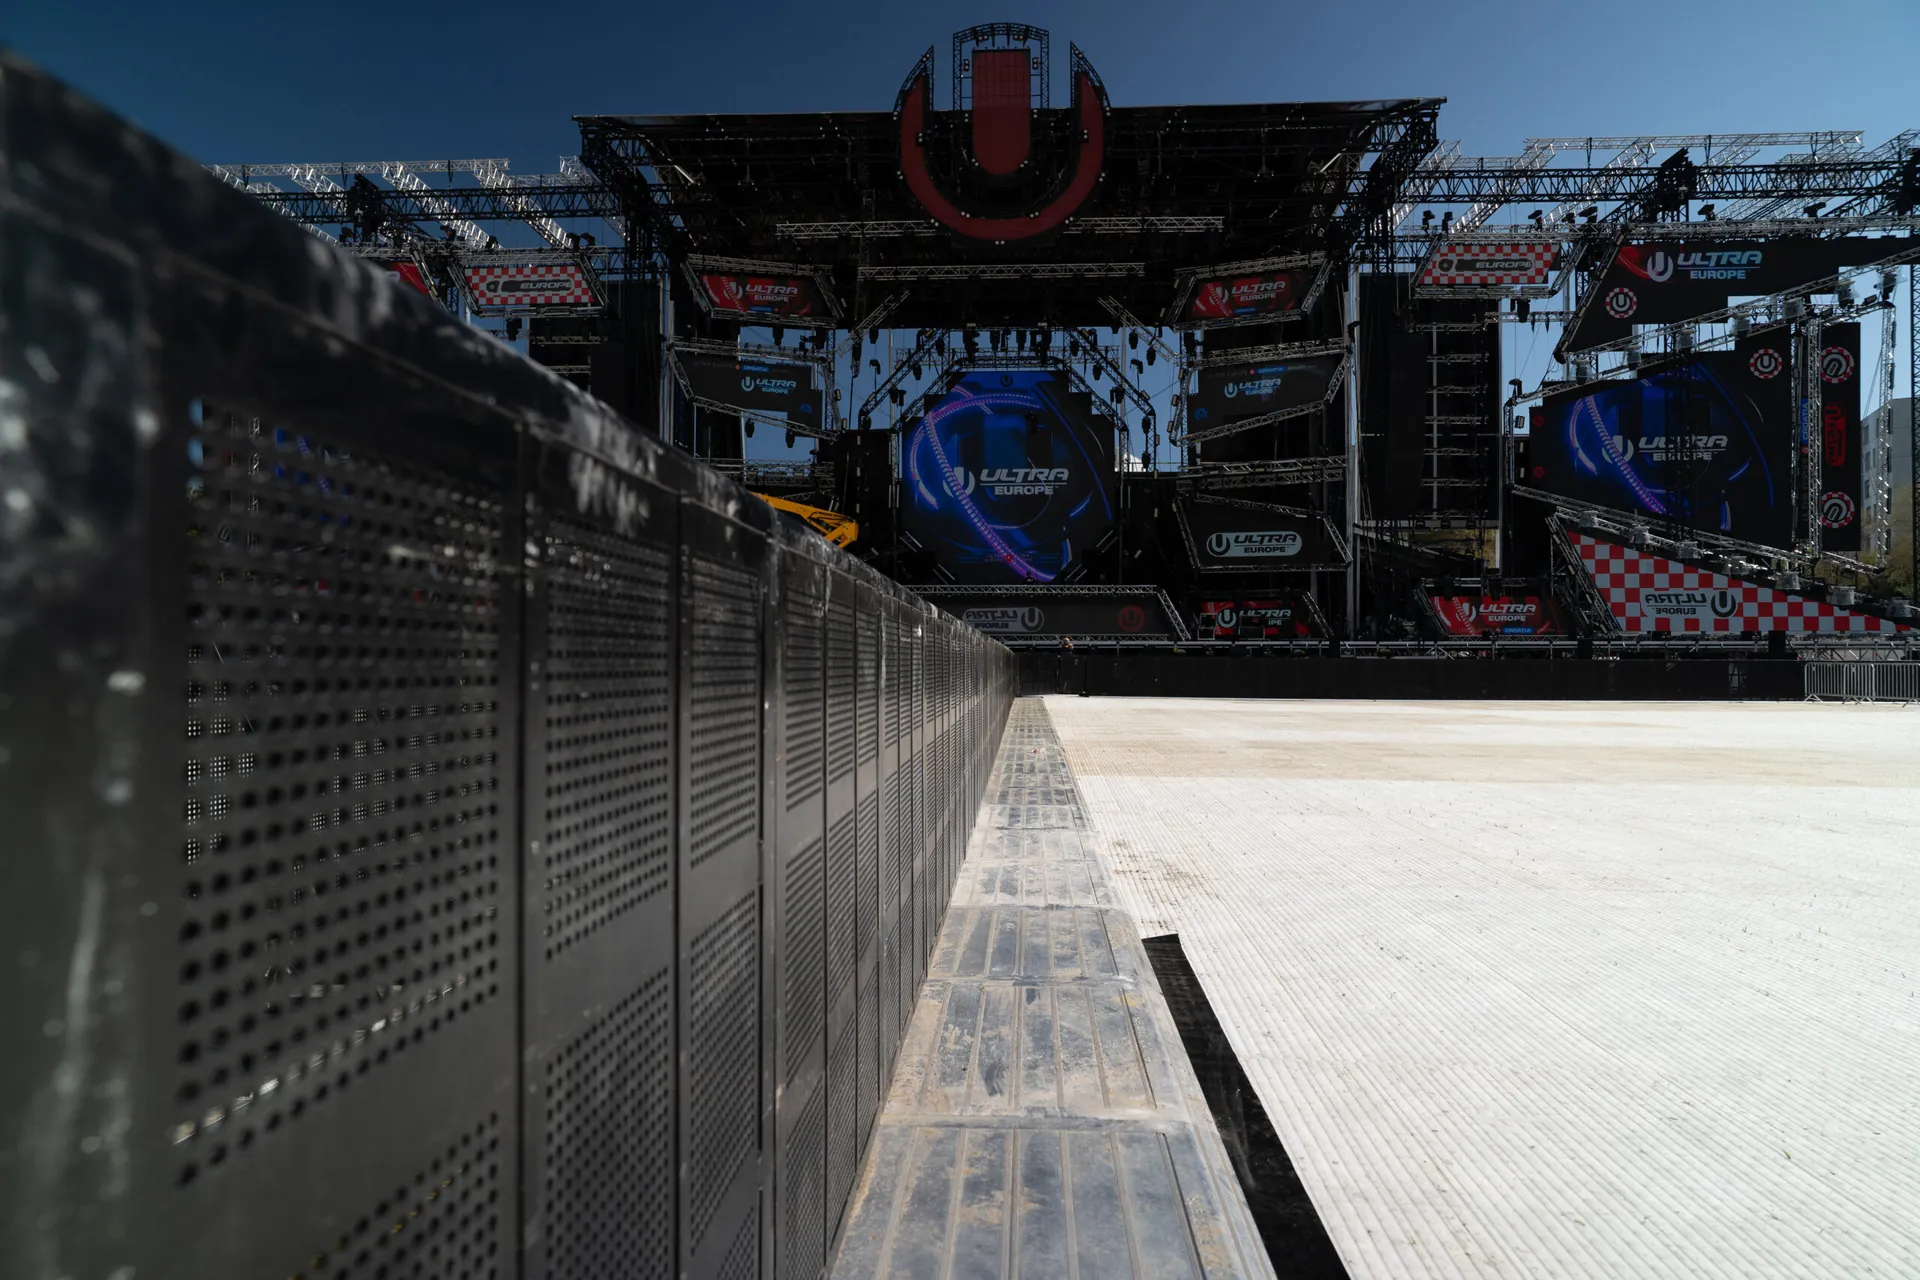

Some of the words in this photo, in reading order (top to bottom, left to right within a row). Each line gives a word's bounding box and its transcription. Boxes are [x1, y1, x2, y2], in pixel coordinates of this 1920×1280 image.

[1677, 250, 1763, 266] ULTRA
[1476, 261, 1531, 269] EUROPE
[1690, 270, 1746, 280] EUROPE
[520, 281, 574, 289] EUROPE
[745, 283, 798, 295] ULTRA
[1231, 281, 1286, 295] ULTRA
[754, 294, 789, 303] EUROPE
[1240, 292, 1277, 302] EUROPE
[756, 377, 797, 388] ULTRA
[1239, 378, 1282, 389] ULTRA
[762, 387, 789, 395] EUROPE
[1245, 388, 1273, 396] EUROPE
[980, 468, 1069, 483] ULTRA
[994, 486, 1054, 496] EUROPE
[1234, 534, 1297, 544] ULTRA
[1479, 604, 1537, 613] ULTRA
